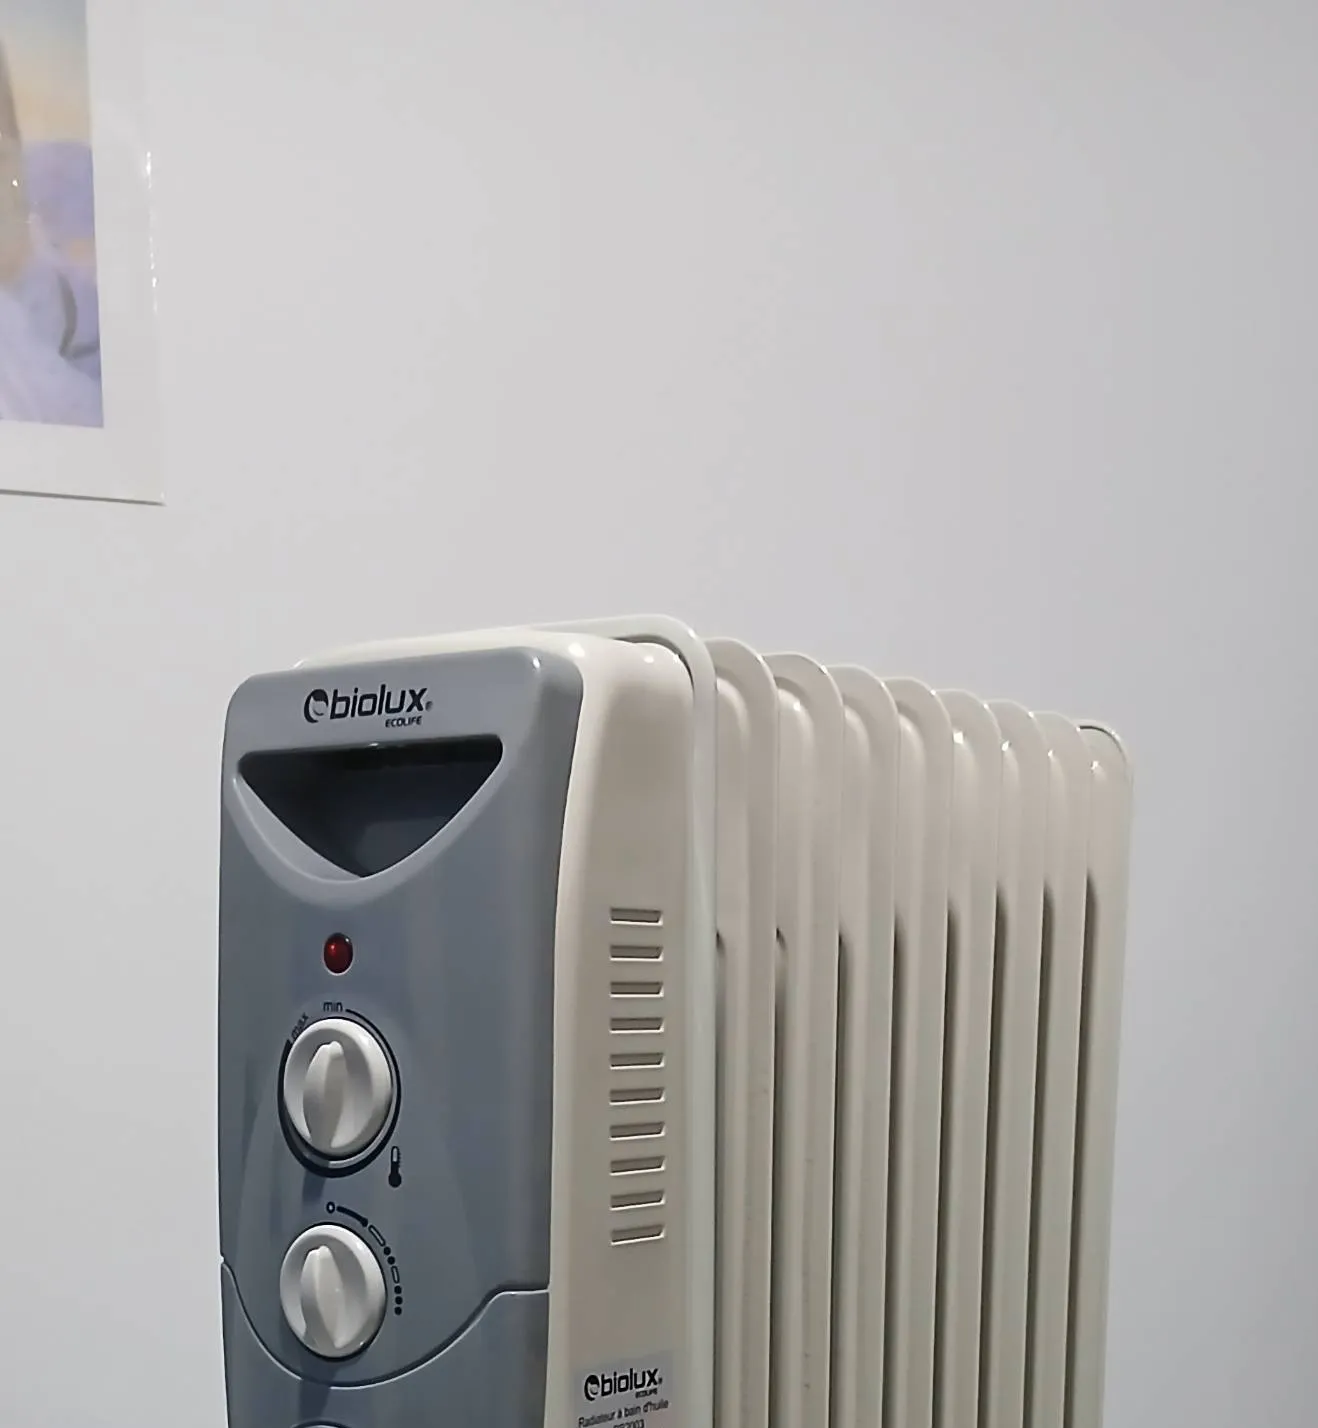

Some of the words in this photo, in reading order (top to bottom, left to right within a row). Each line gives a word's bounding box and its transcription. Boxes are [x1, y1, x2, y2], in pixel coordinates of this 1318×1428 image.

[385, 716, 422, 728] ECOLIFE
[323, 1001, 343, 1012] min
[291, 1012, 309, 1041] max
[624, 1405, 641, 1418] bain
